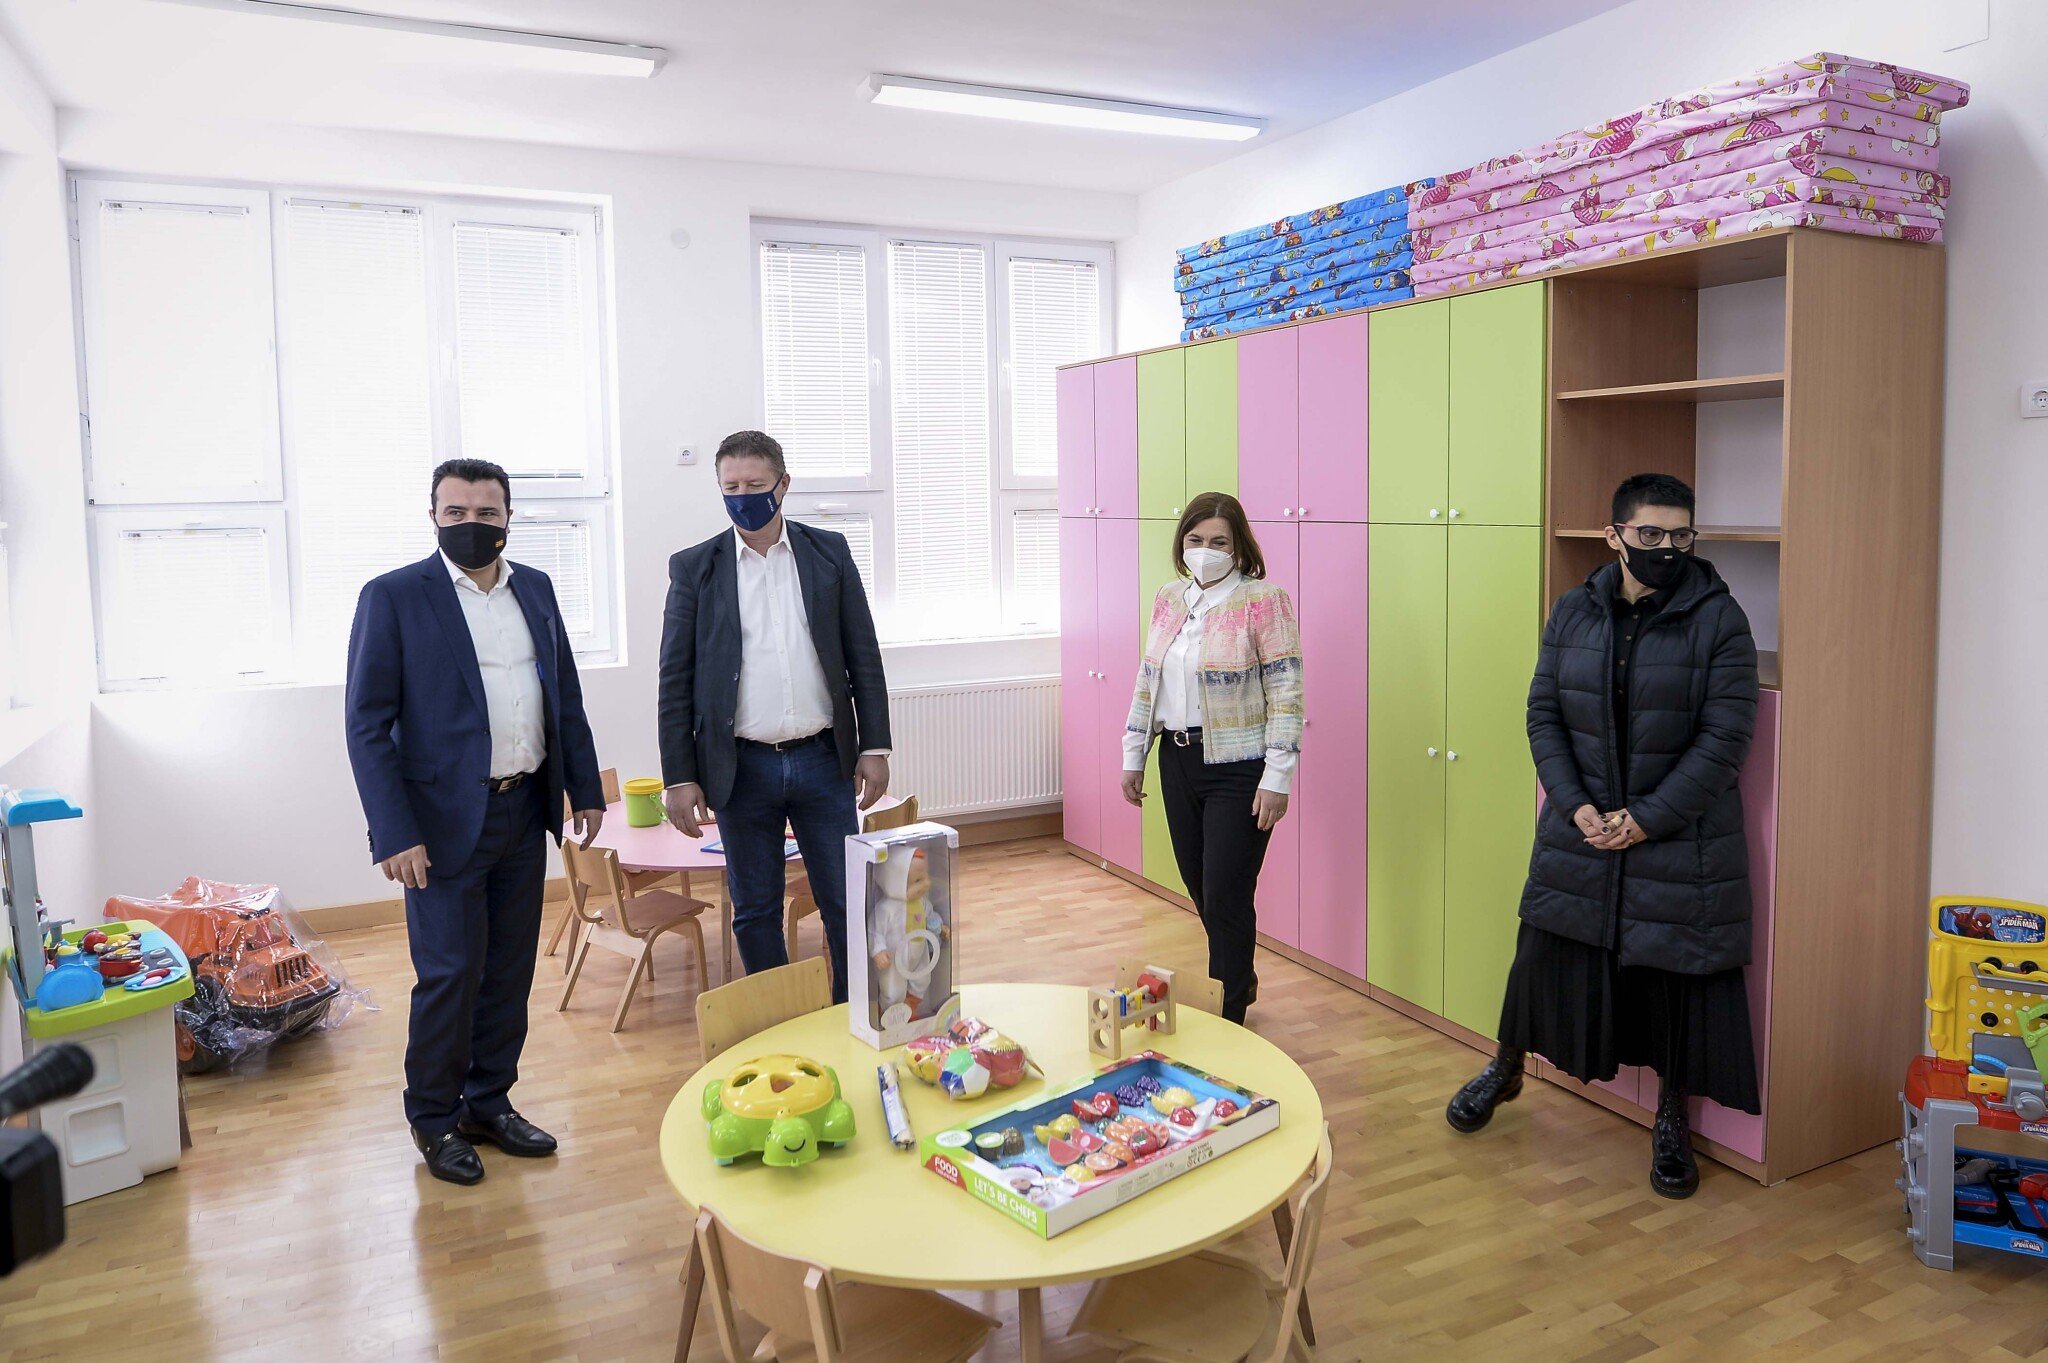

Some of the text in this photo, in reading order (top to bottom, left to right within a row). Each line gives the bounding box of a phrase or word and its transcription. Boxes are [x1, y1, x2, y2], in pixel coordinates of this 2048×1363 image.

[934, 1156, 958, 1178] FOOD
[974, 1177, 996, 1198] LET'S
[997, 1193, 1008, 1206] BE
[1010, 1199, 1038, 1224] CHEFS
